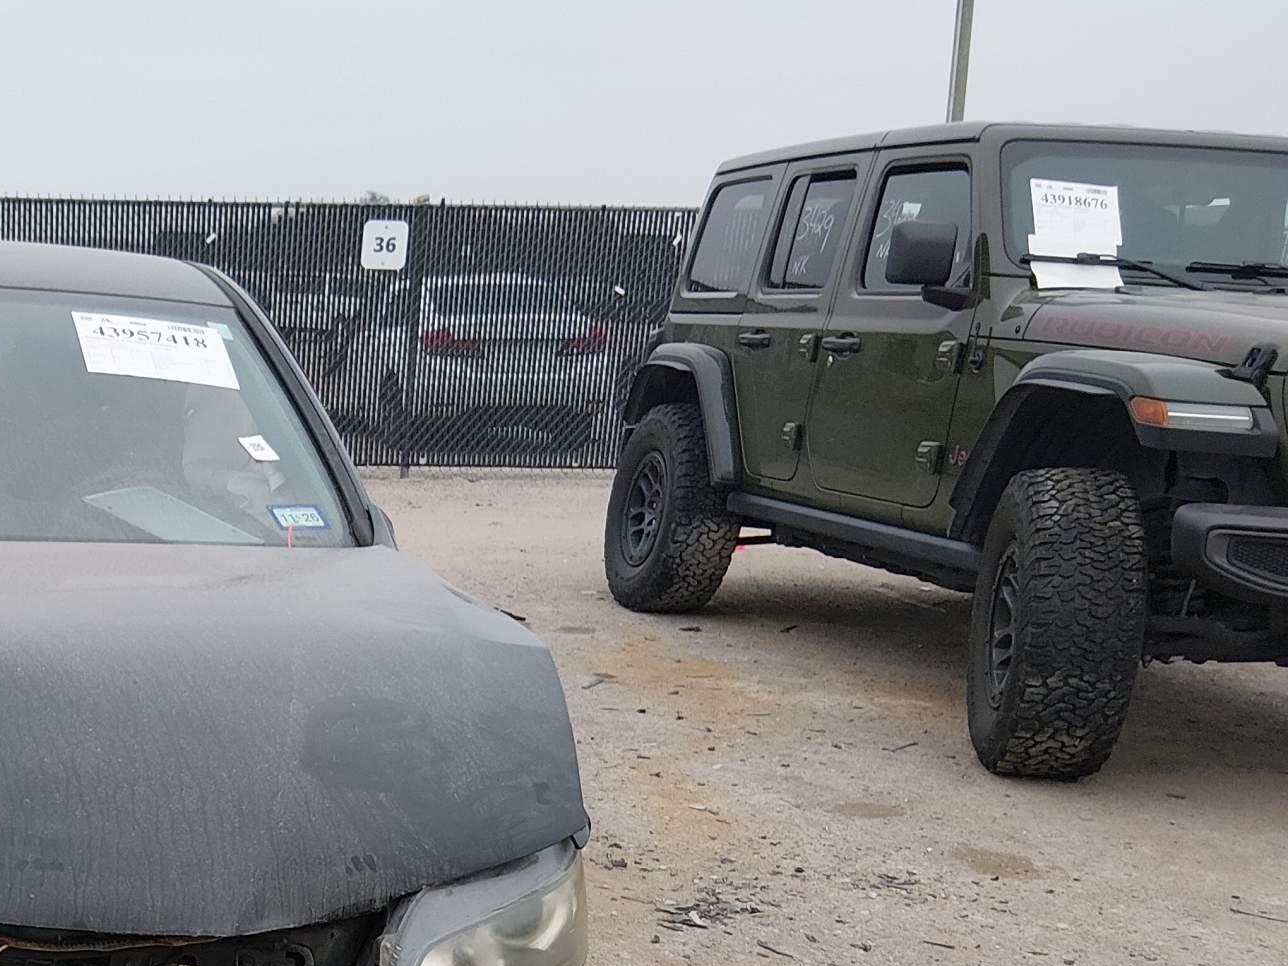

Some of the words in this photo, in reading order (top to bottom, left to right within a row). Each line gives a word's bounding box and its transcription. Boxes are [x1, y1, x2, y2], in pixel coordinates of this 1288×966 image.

[1040, 193, 1108, 209] 43918676
[373, 236, 396, 253] 36
[93, 325, 208, 349] 43957418
[1043, 316, 1238, 353] RUBICON
